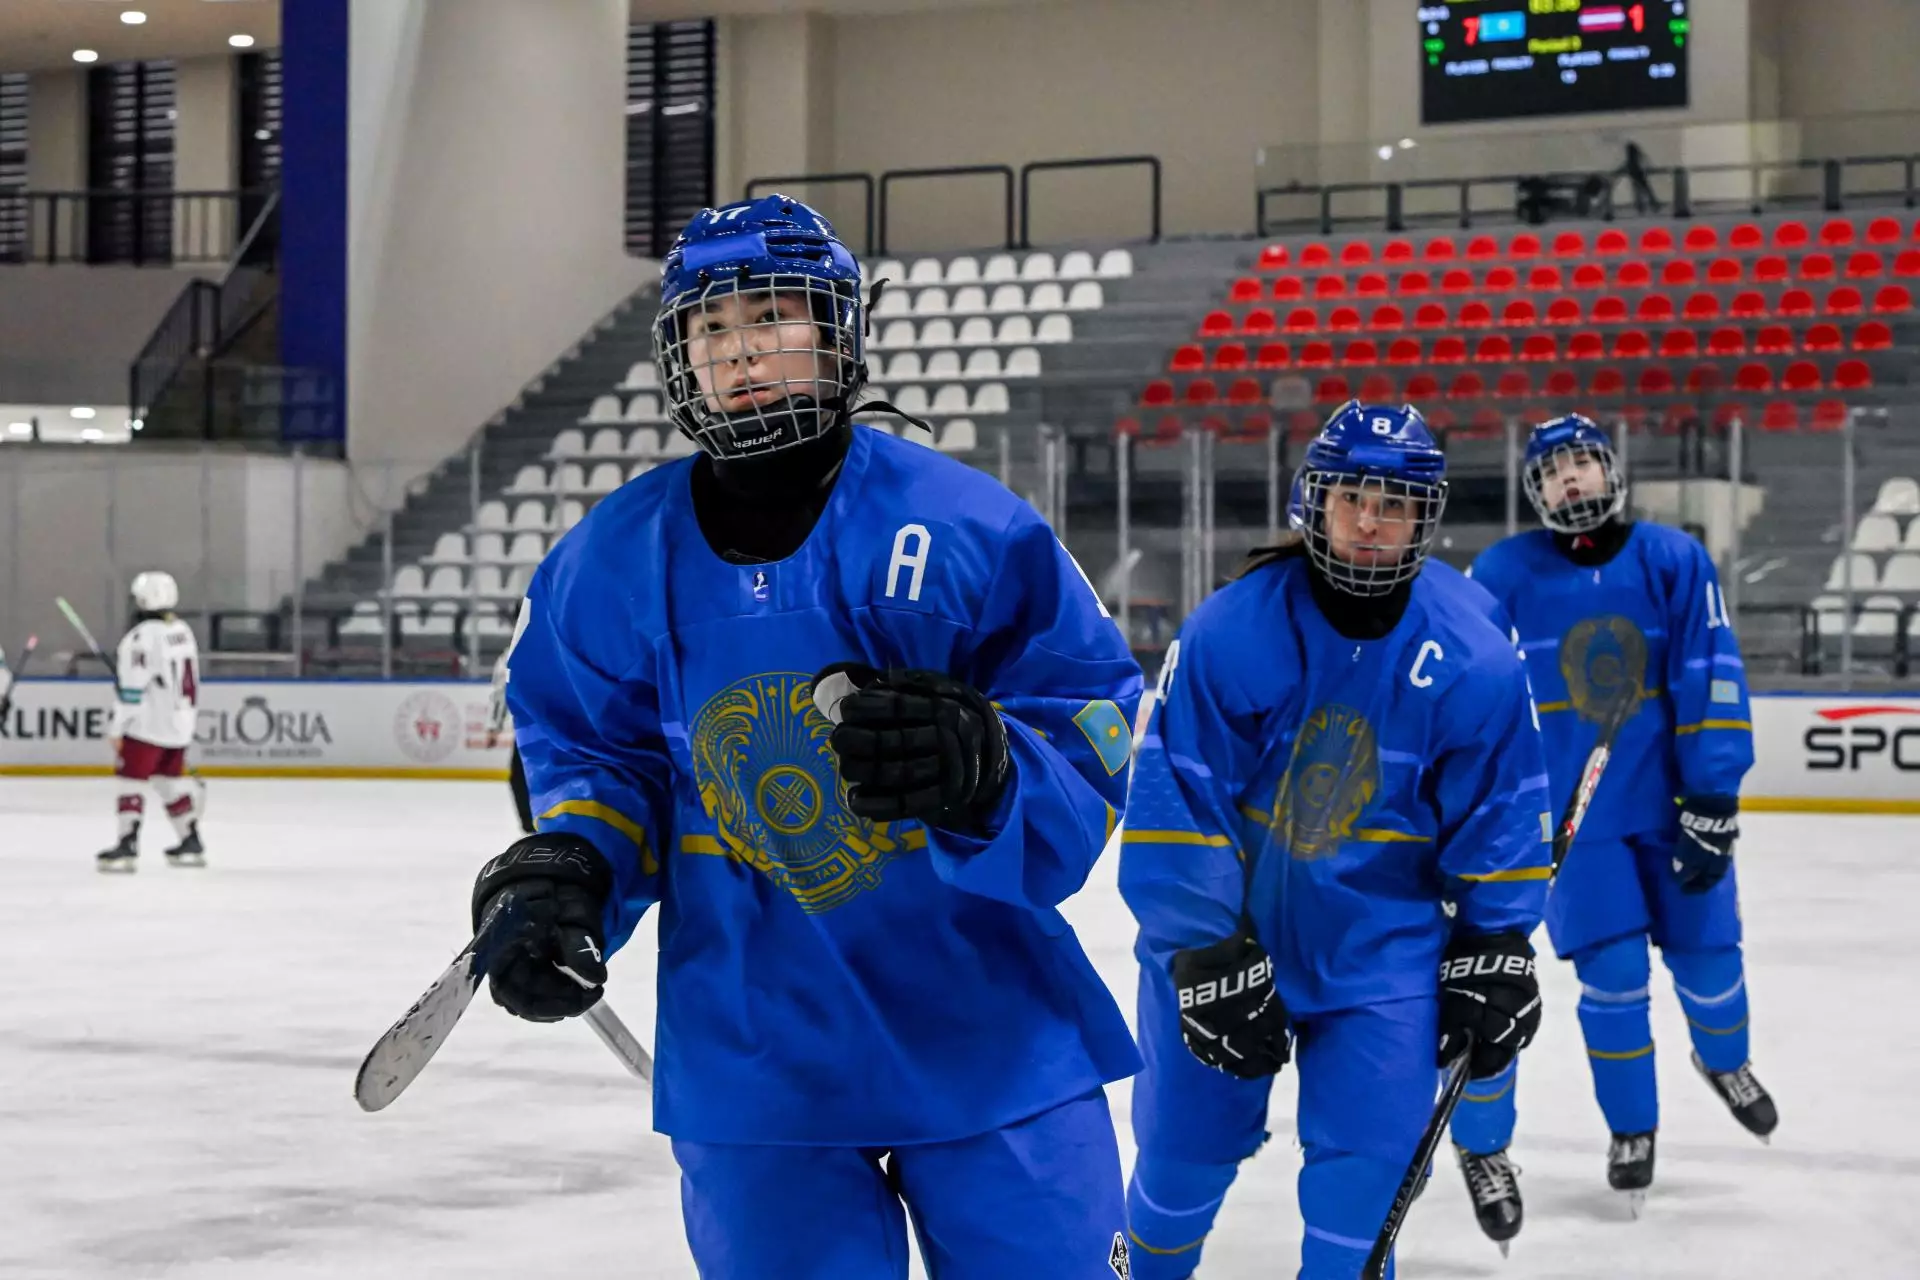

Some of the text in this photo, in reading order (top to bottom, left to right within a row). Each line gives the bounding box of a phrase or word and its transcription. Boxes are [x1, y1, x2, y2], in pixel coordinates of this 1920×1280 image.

[1462, 16, 1480, 47] 7
[1628, 3, 1645, 33] 1
[1371, 417, 1392, 435] 8
[885, 523, 932, 602] A
[1409, 639, 1444, 689] C
[0, 706, 115, 739] LINE
[193, 697, 333, 746] GLORIA
